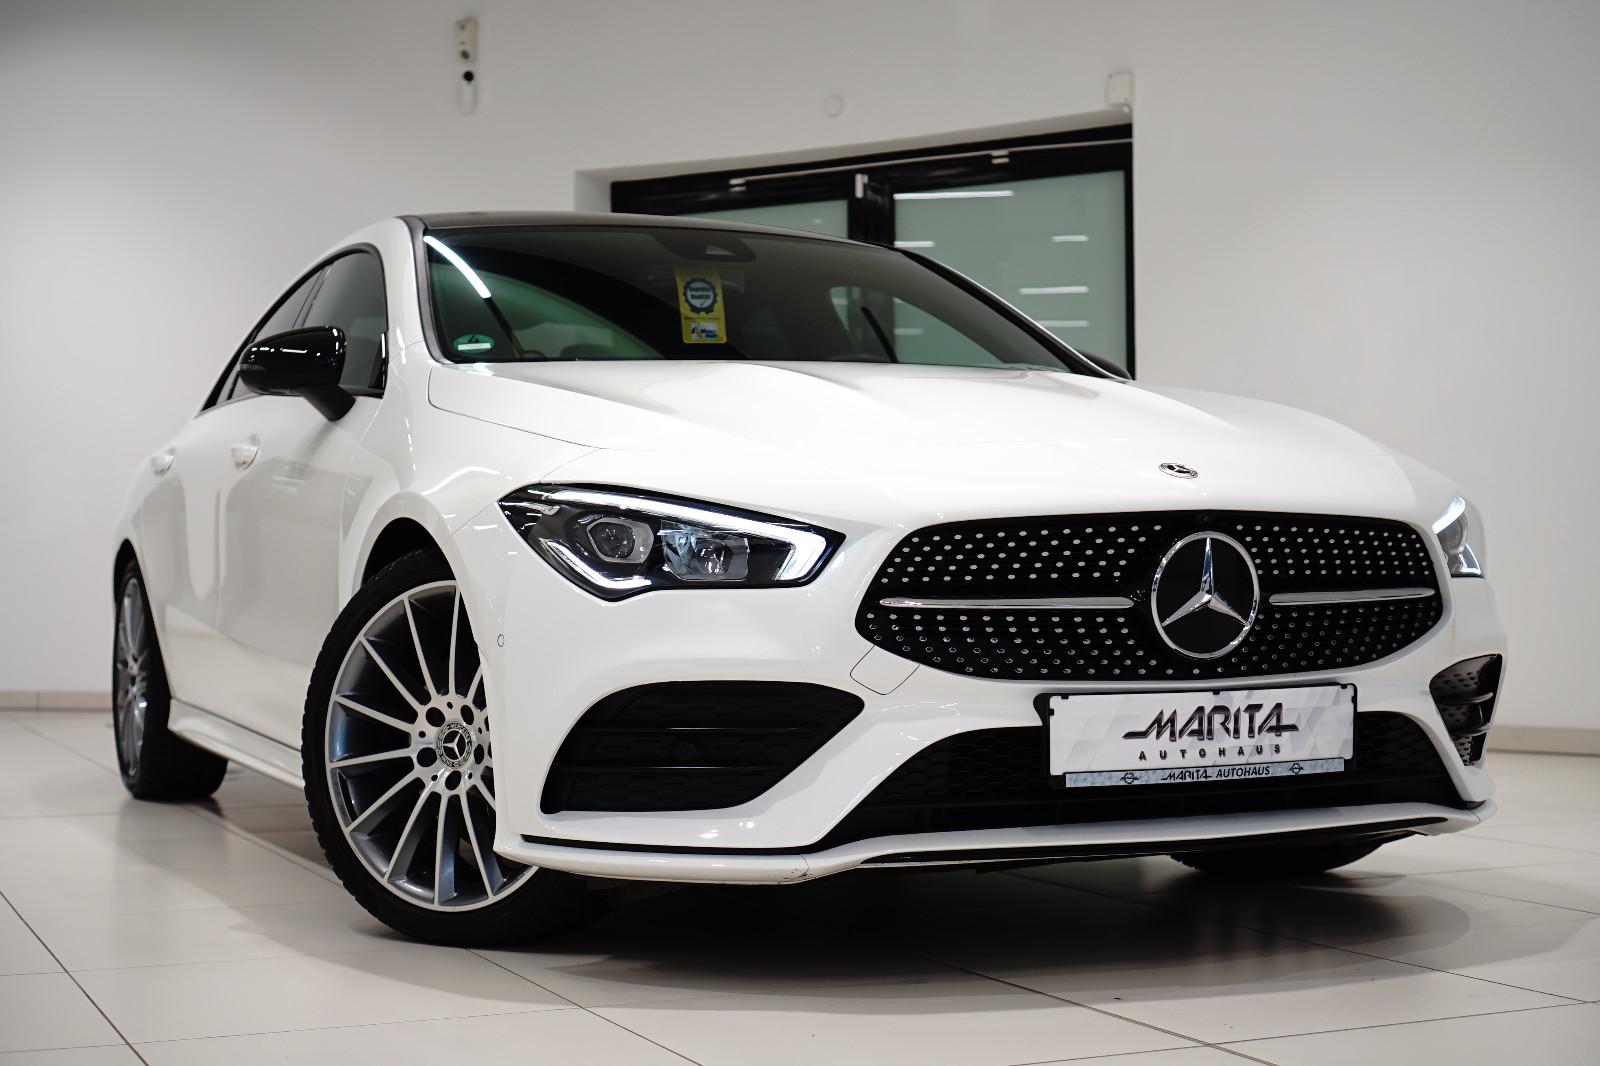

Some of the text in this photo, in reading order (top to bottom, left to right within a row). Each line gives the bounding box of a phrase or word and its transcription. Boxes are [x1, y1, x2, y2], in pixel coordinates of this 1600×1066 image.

[1122, 703, 1299, 741] MARITA
[1139, 745, 1281, 761] AUTOHAUS
[1161, 766, 1270, 781] MARITA AUTOHAUS
